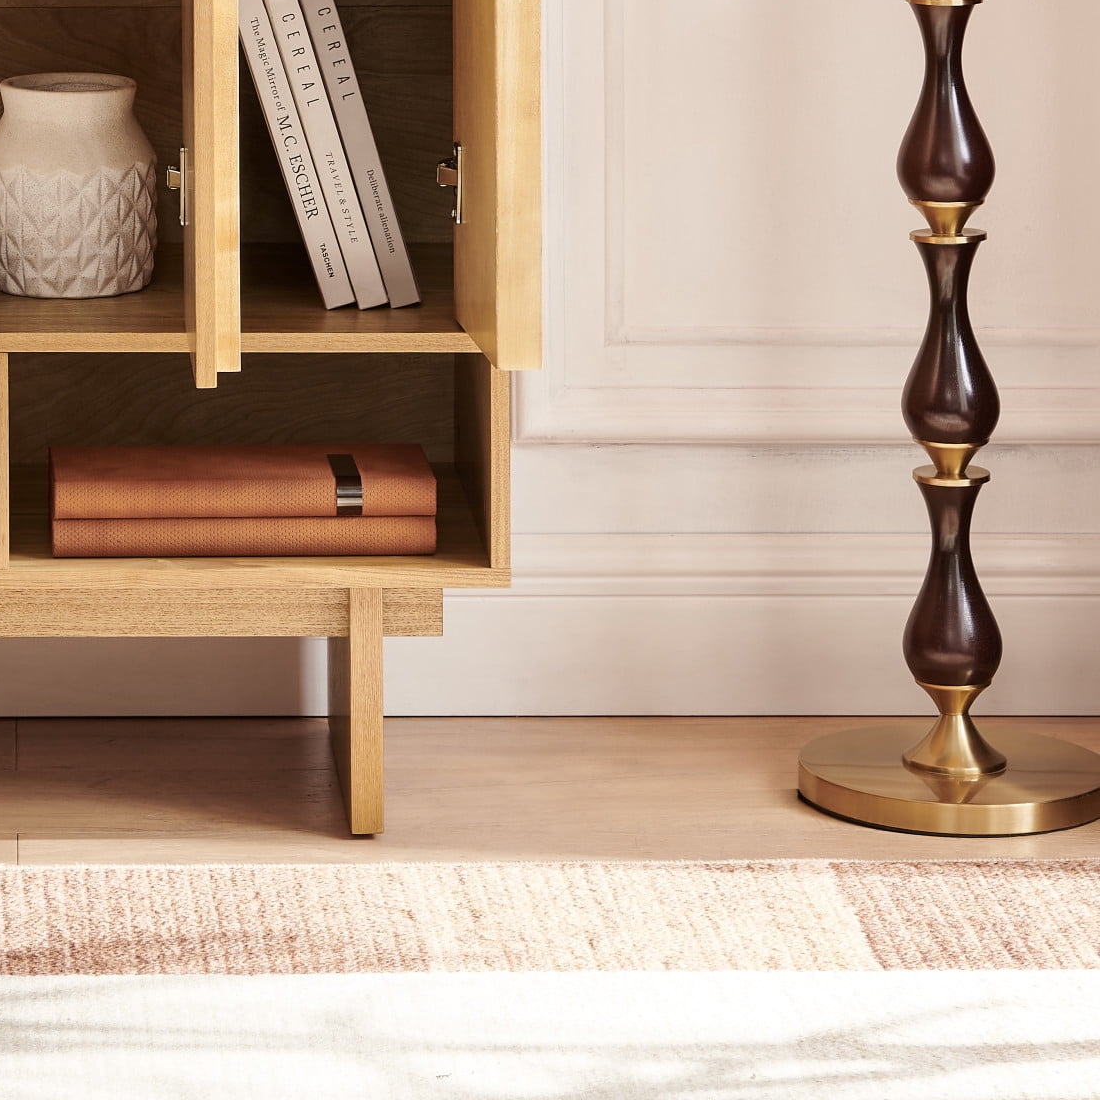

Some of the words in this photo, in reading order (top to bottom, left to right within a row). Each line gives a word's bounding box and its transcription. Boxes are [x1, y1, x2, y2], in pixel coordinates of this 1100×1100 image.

[282, 13, 320, 107] CEREAL
[317, 7, 355, 100] CEREAL
[250, 16, 260, 36] The
[256, 37, 270, 66] Magic
[265, 67, 280, 100] Mirror
[275, 101, 286, 111] of
[289, 154, 319, 220] ESCHER
[325, 152, 343, 195] TRAVEL
[341, 208, 358, 243] STYLE
[366, 169, 383, 212] Deliberate
[379, 212, 396, 254] alienation
[319, 243, 335, 278] TASCHEN
